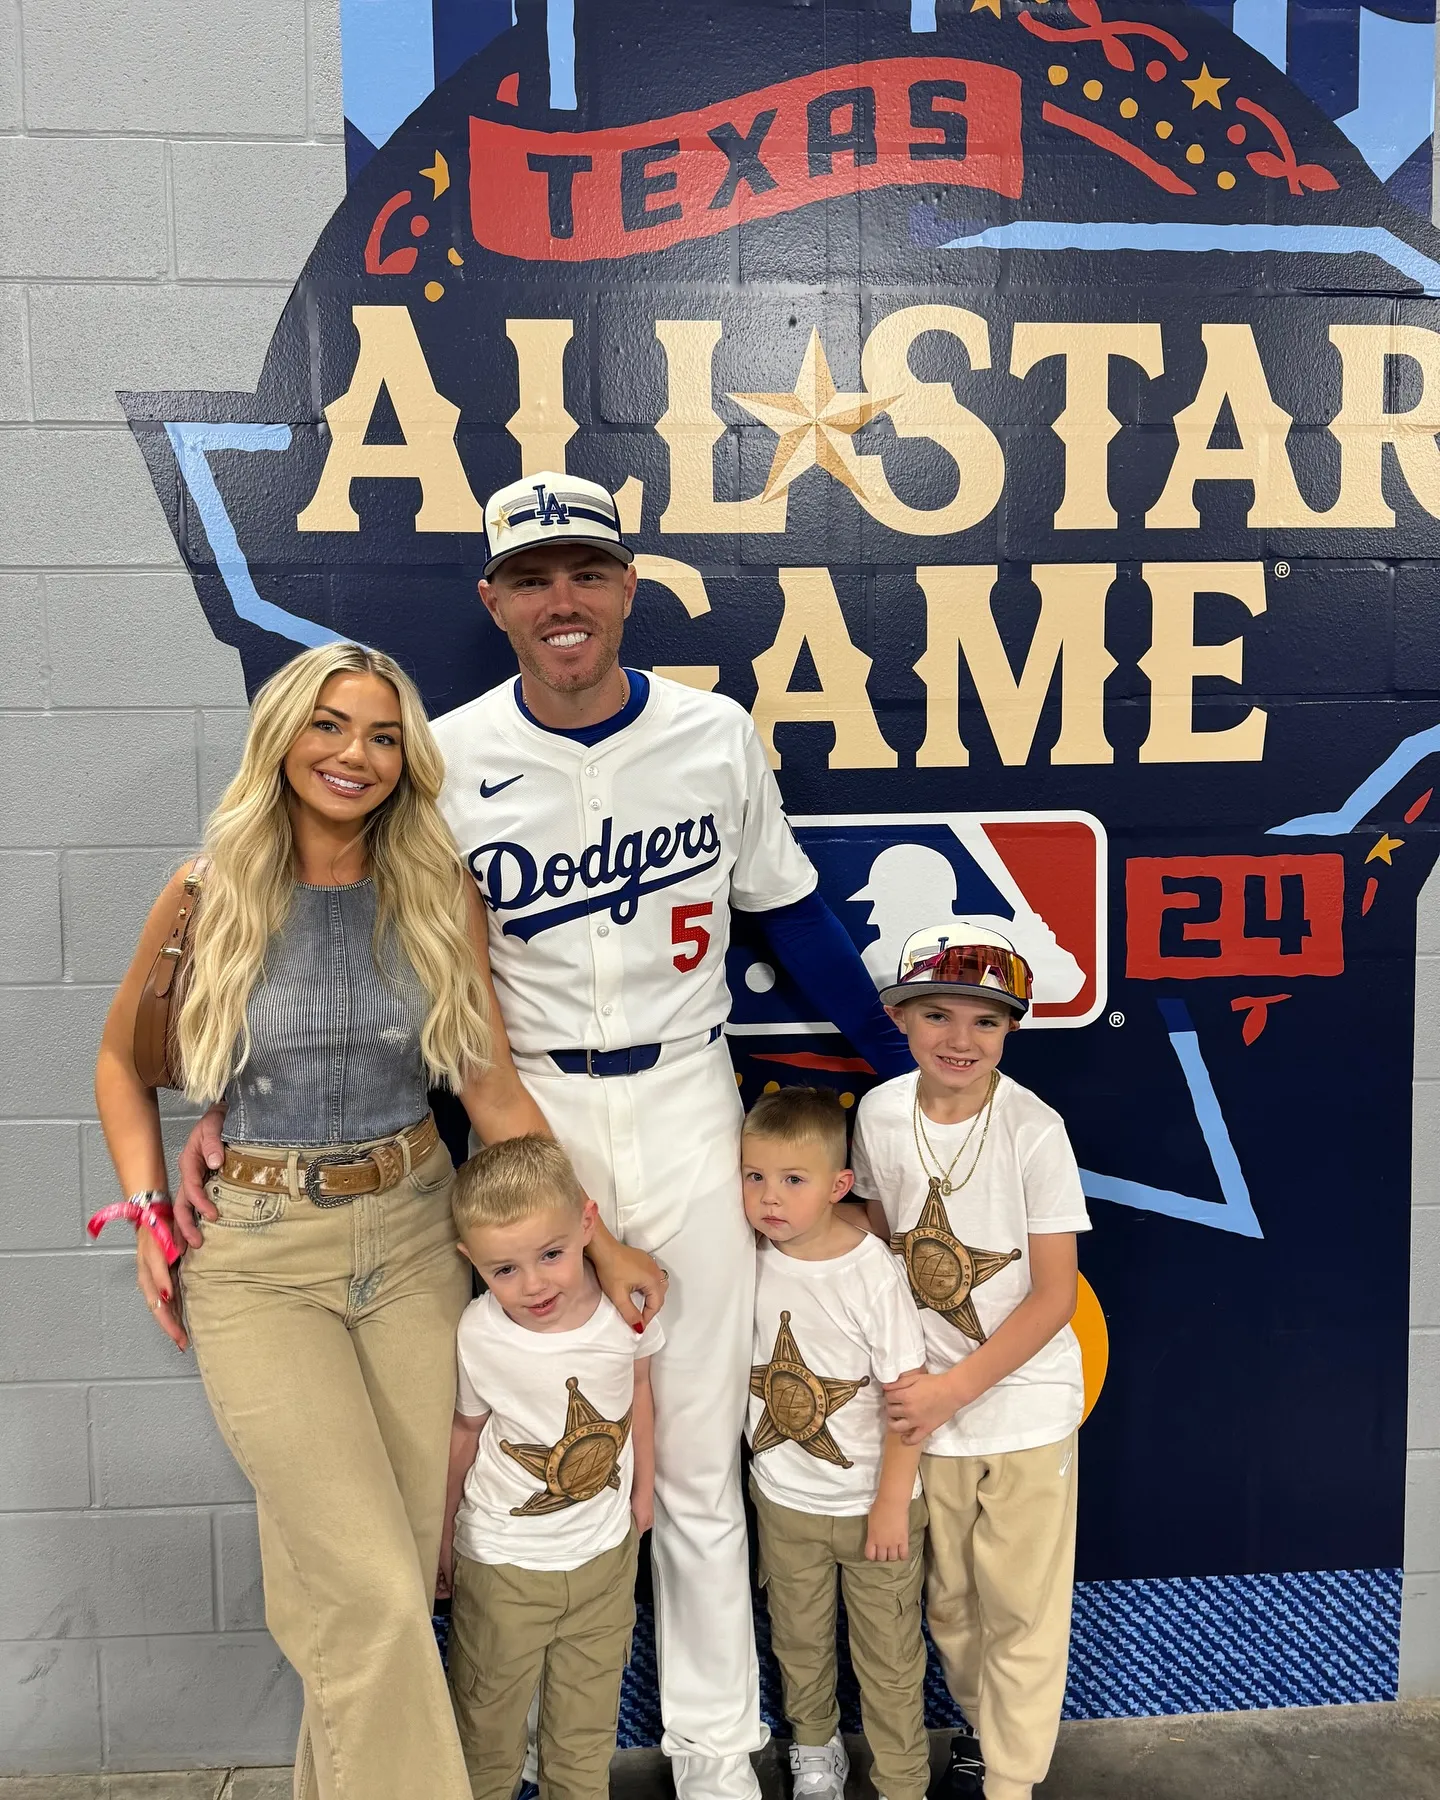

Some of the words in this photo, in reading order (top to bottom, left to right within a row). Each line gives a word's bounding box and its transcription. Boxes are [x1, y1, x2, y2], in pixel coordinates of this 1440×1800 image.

[526, 80, 968, 240] TEXAS
[297, 305, 787, 535] ALL
[861, 304, 1440, 537] STAR
[533, 484, 570, 526] LA
[468, 813, 721, 926] Dodgers
[1159, 873, 1312, 958] 24
[671, 901, 713, 973] 5
